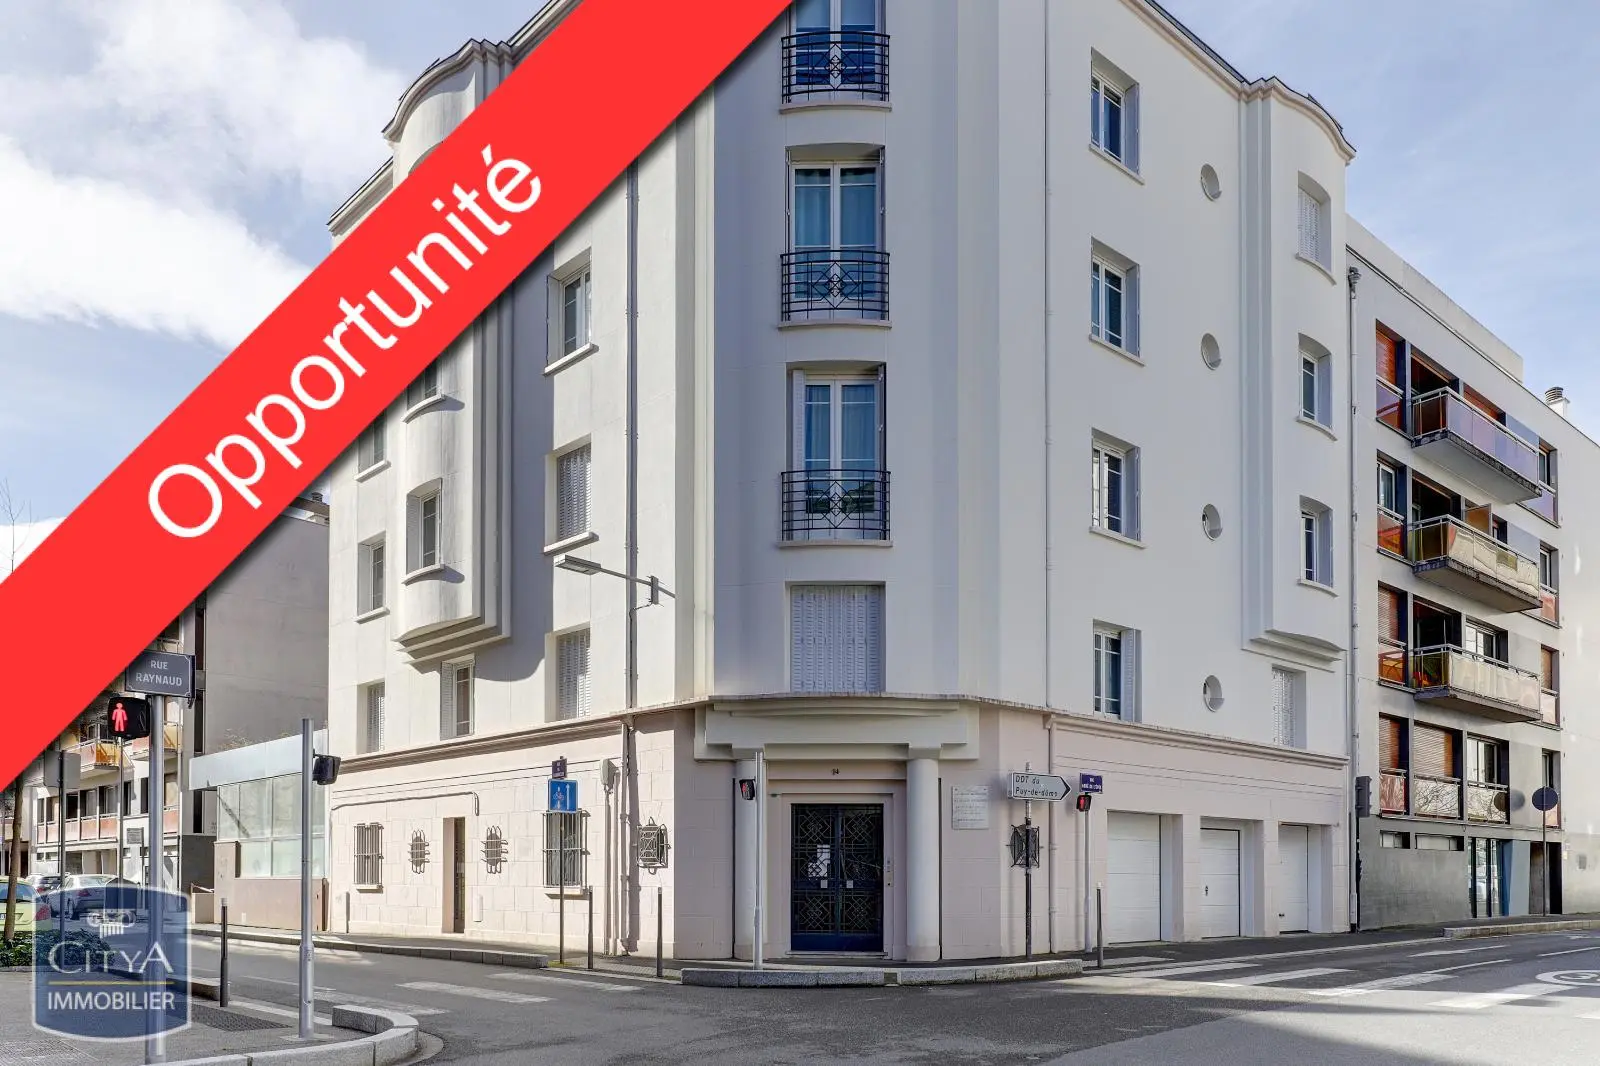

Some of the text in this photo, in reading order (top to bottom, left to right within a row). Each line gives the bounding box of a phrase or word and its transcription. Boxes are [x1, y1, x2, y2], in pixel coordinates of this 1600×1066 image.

[150, 660, 169, 670] RUE
[135, 672, 183, 687] RAYNAUD
[1015, 775, 1029, 783] DDT
